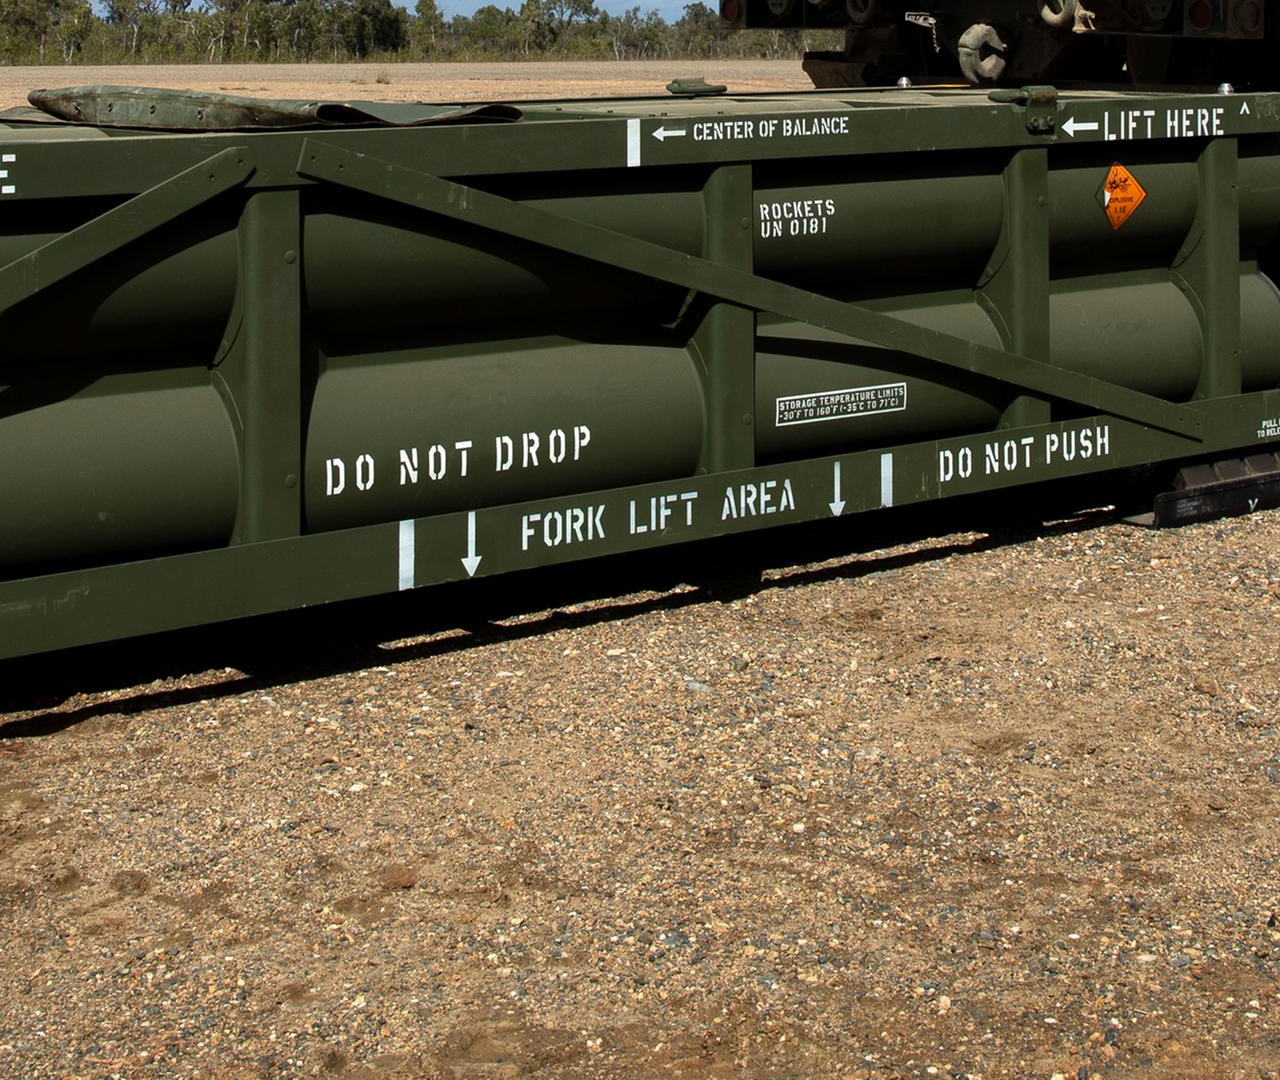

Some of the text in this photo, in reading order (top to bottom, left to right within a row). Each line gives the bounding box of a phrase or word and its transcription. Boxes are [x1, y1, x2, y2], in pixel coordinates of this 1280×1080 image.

[693, 116, 849, 141] CENTER OF BALANCE
[1104, 110, 1155, 141] LIFT
[1167, 108, 1224, 138] HERE
[760, 199, 835, 220] ROCKETS
[761, 217, 826, 238] UN 0181
[779, 387, 904, 411] STORAGE TEMPERATURE LIMITS
[804, 408, 814, 417] TO
[867, 400, 877, 409] TO
[1256, 430, 1266, 439] TO
[1262, 419, 1278, 429] PULL
[326, 425, 591, 496] DO NOT DROP
[939, 425, 1109, 482] DO NOT PUSH
[521, 478, 796, 551] FORK LIFT AREA
